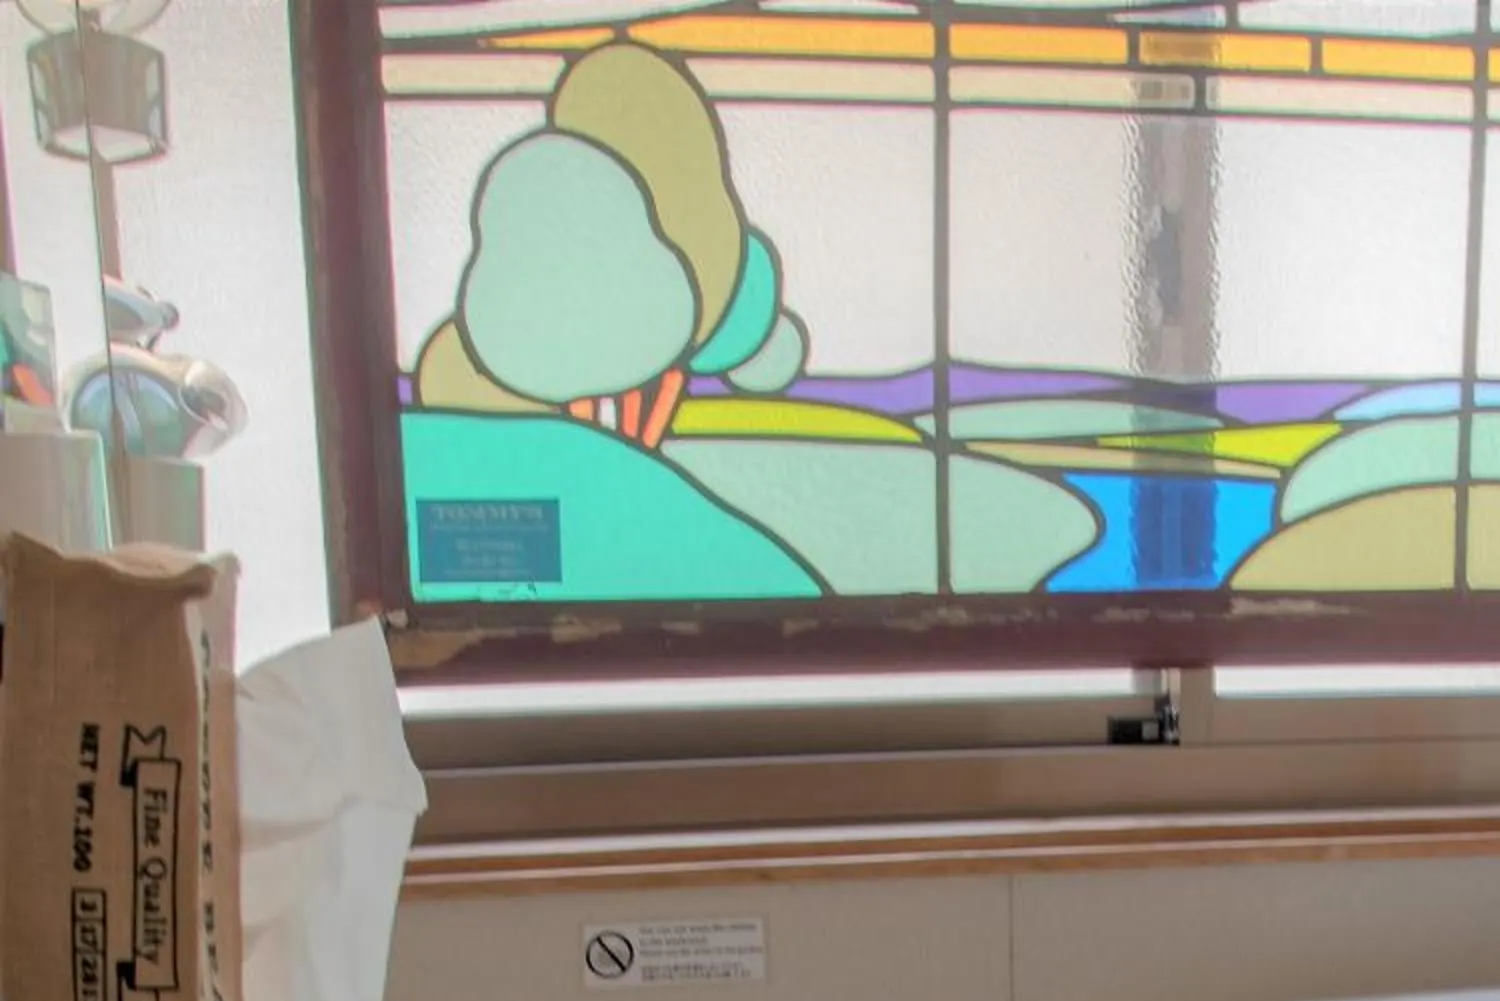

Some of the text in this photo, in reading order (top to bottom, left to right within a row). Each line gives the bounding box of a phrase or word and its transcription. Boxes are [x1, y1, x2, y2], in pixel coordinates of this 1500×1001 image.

[79, 722, 100, 773] NET
[135, 787, 168, 966] Fine Quality
